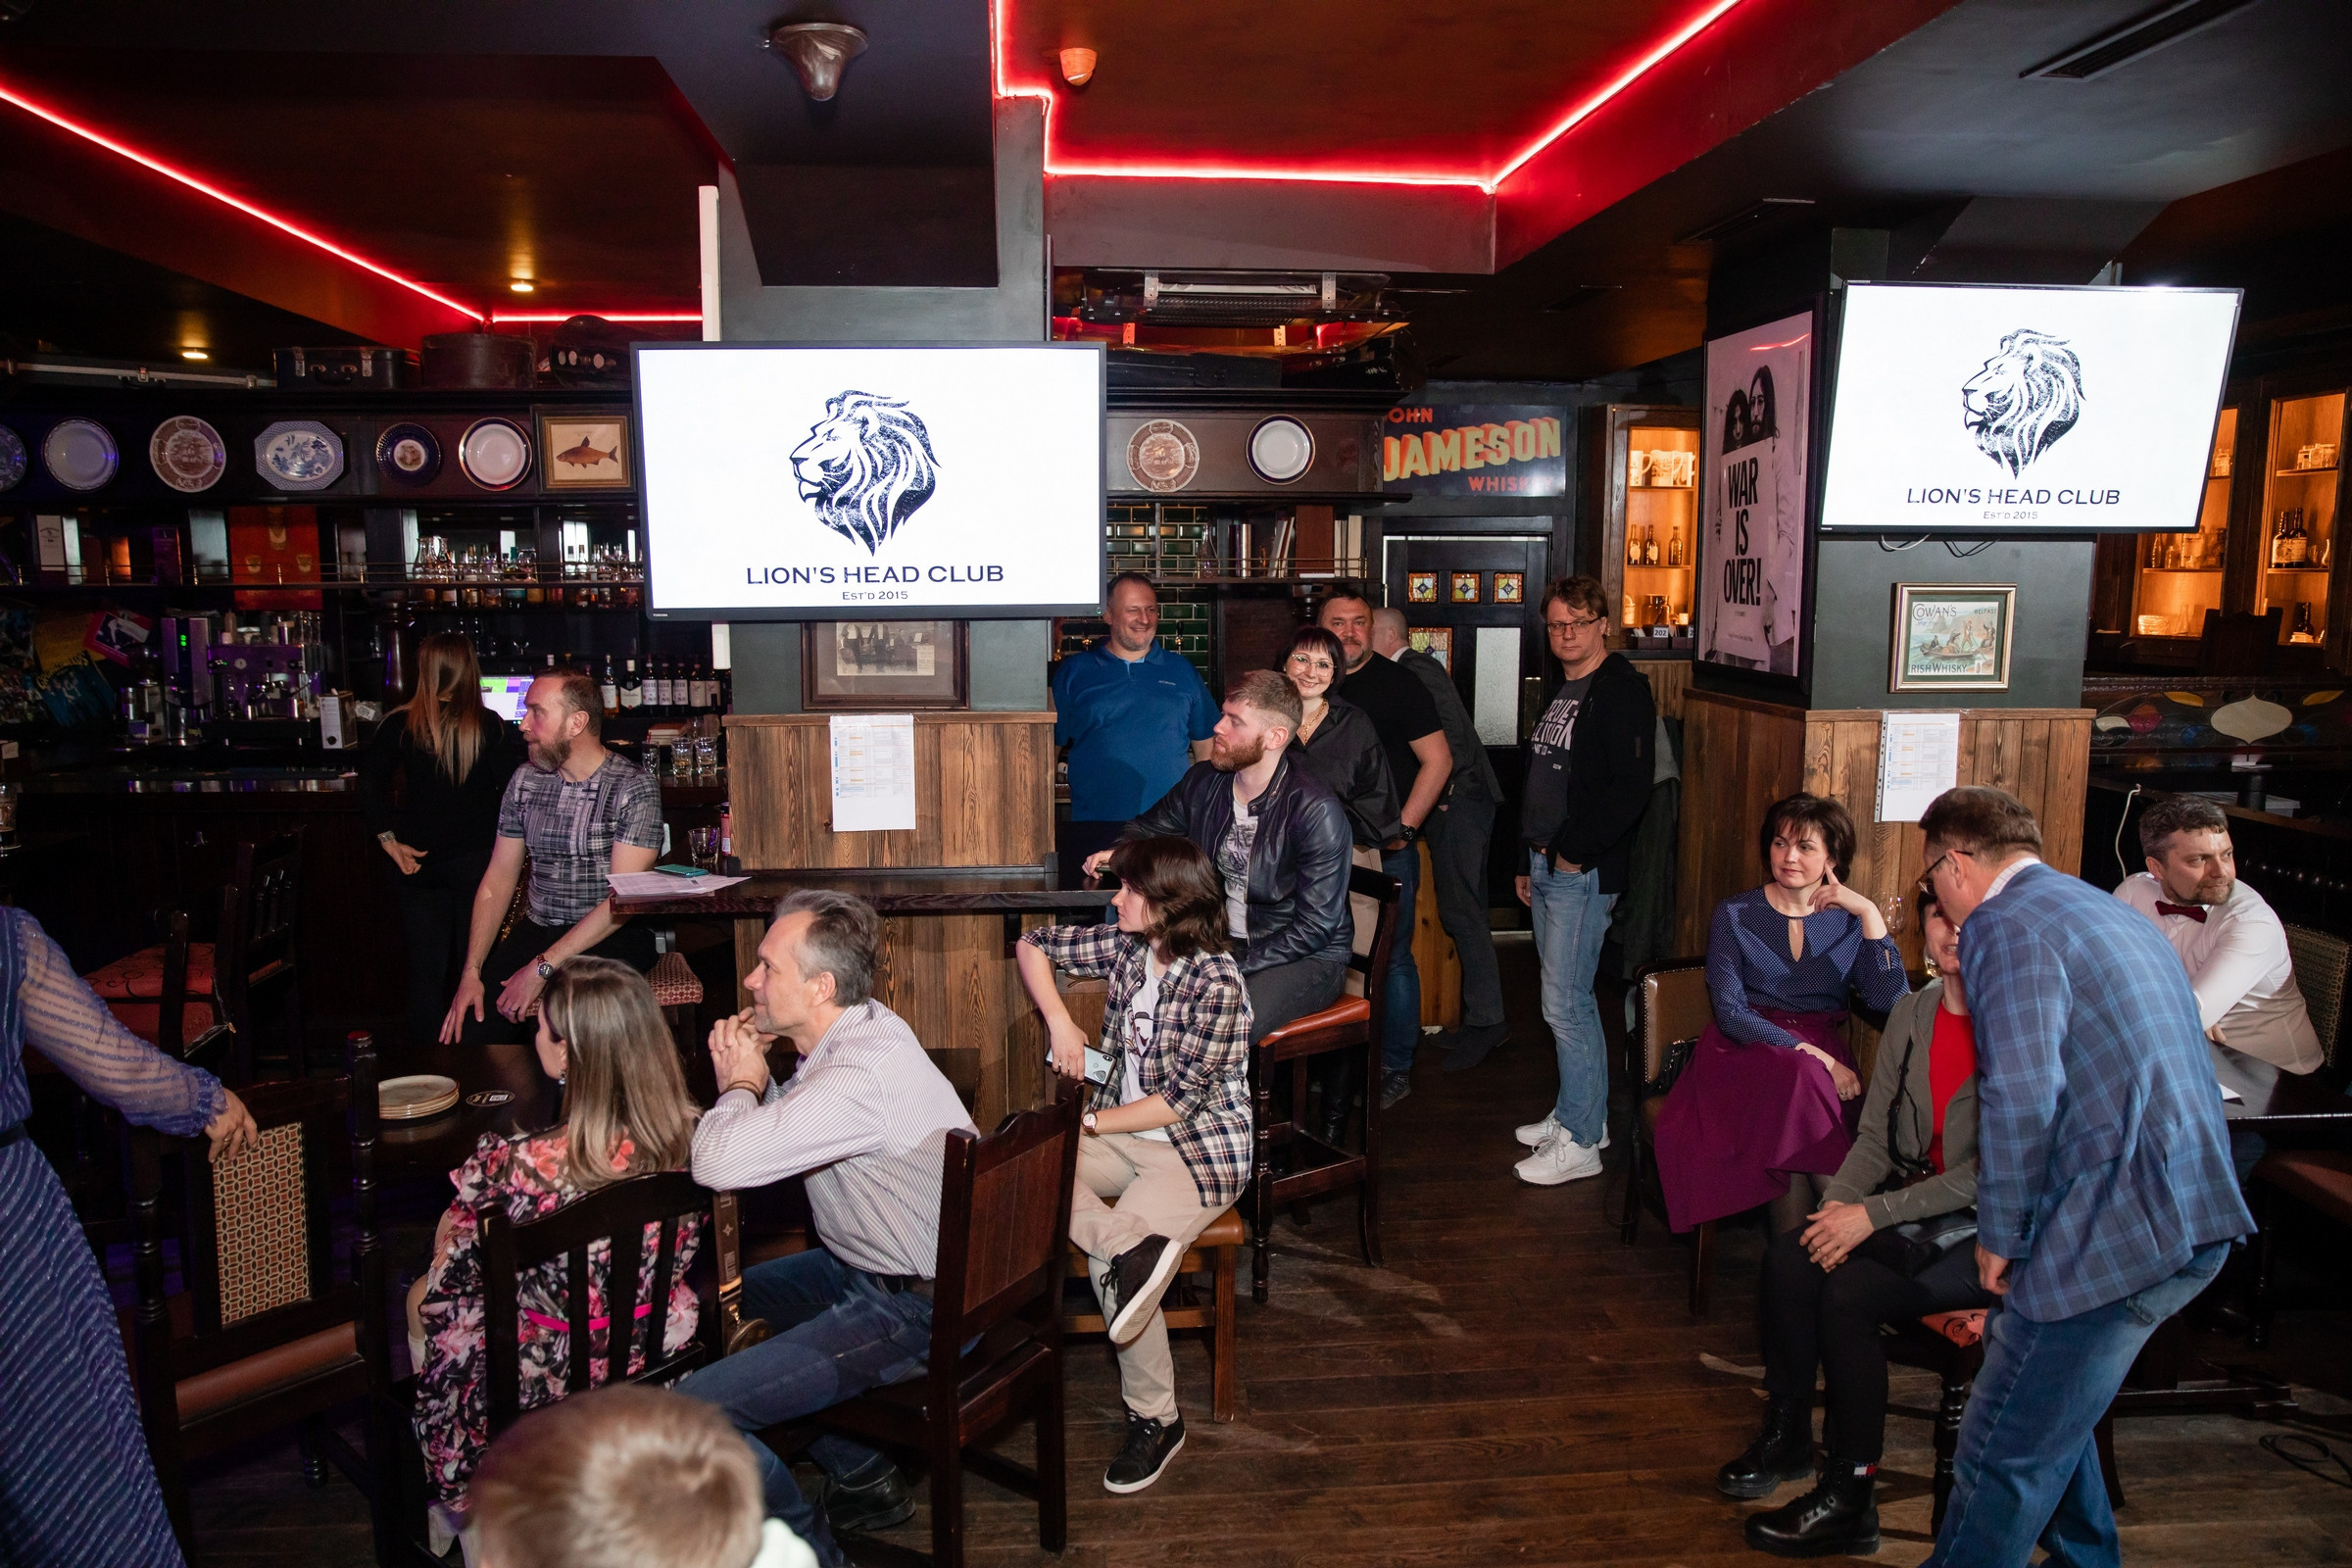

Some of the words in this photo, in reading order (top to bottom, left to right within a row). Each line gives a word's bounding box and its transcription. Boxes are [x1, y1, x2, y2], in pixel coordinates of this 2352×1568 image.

[1384, 407, 1434, 423] OHN
[1384, 416, 1561, 482] JAMESON
[1728, 457, 1758, 509] WAR
[1906, 488, 1982, 505] LION'S
[1987, 489, 2051, 505] HEAD
[2057, 489, 2121, 505] CLUB
[2013, 511, 2038, 520] 2015
[1735, 508, 1749, 556] IS
[747, 566, 836, 585] LION'S
[843, 565, 920, 584] HEAD
[928, 564, 1004, 583] CLUB
[1723, 558, 1762, 606] OVER!
[878, 589, 908, 600] 2015
[1932, 662, 1968, 673] WHISKY
